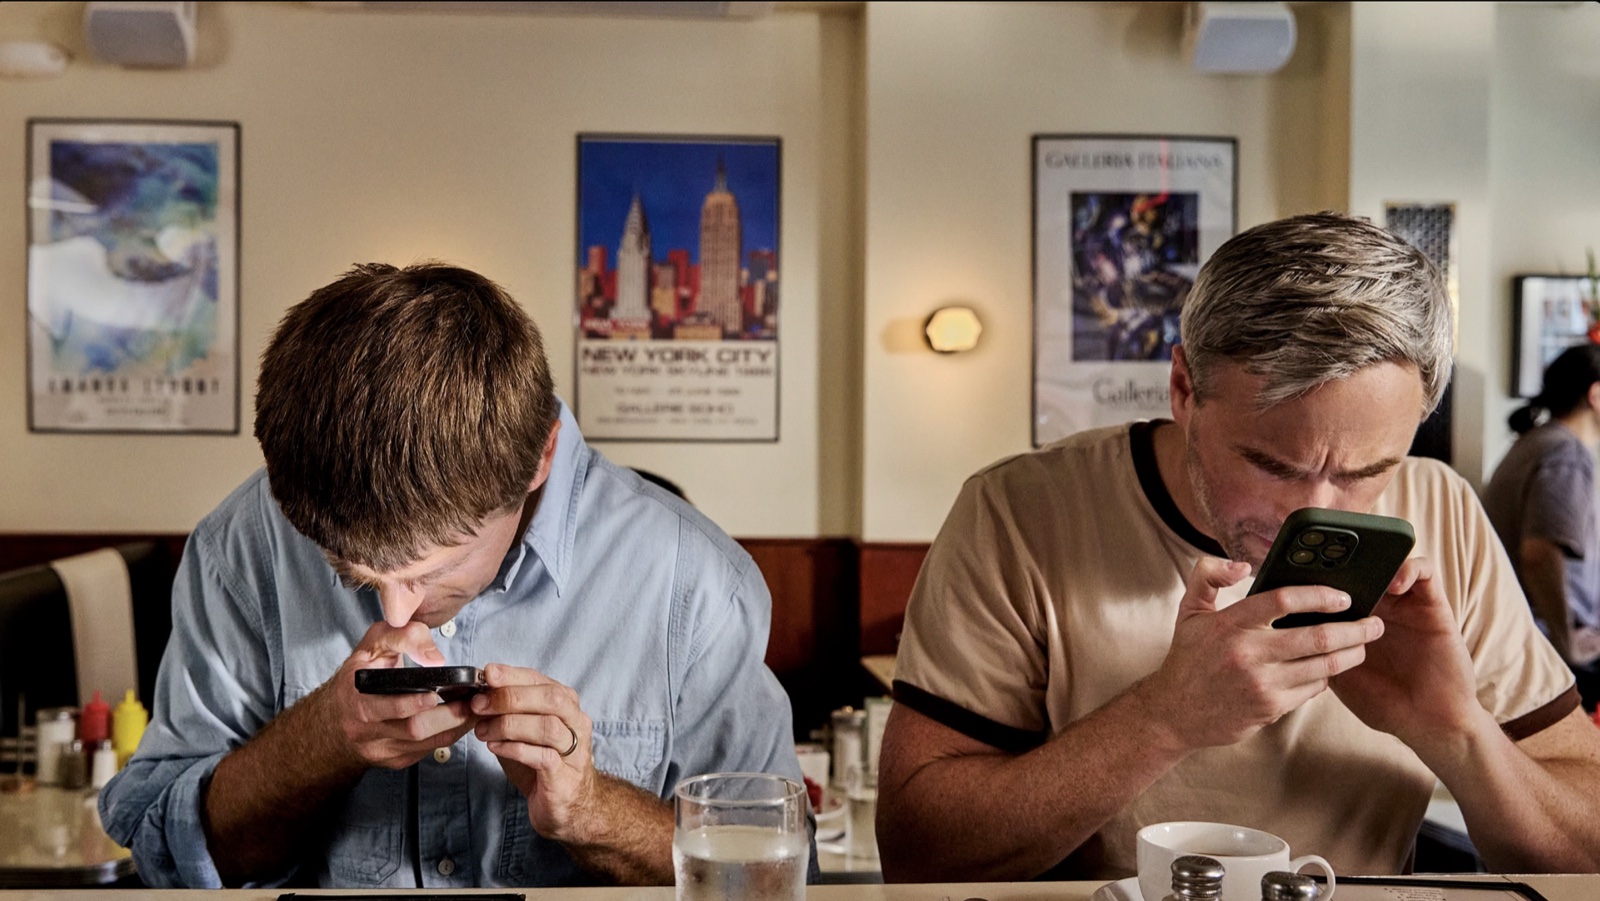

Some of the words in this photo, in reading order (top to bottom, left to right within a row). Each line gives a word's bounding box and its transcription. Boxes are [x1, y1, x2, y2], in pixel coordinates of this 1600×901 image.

[1045, 152, 1134, 169] GALLERIA
[582, 346, 637, 363] NEW
[645, 347, 708, 363] YORK
[716, 347, 772, 364] CITY
[582, 365, 617, 377] NEW
[622, 365, 661, 377] YORK
